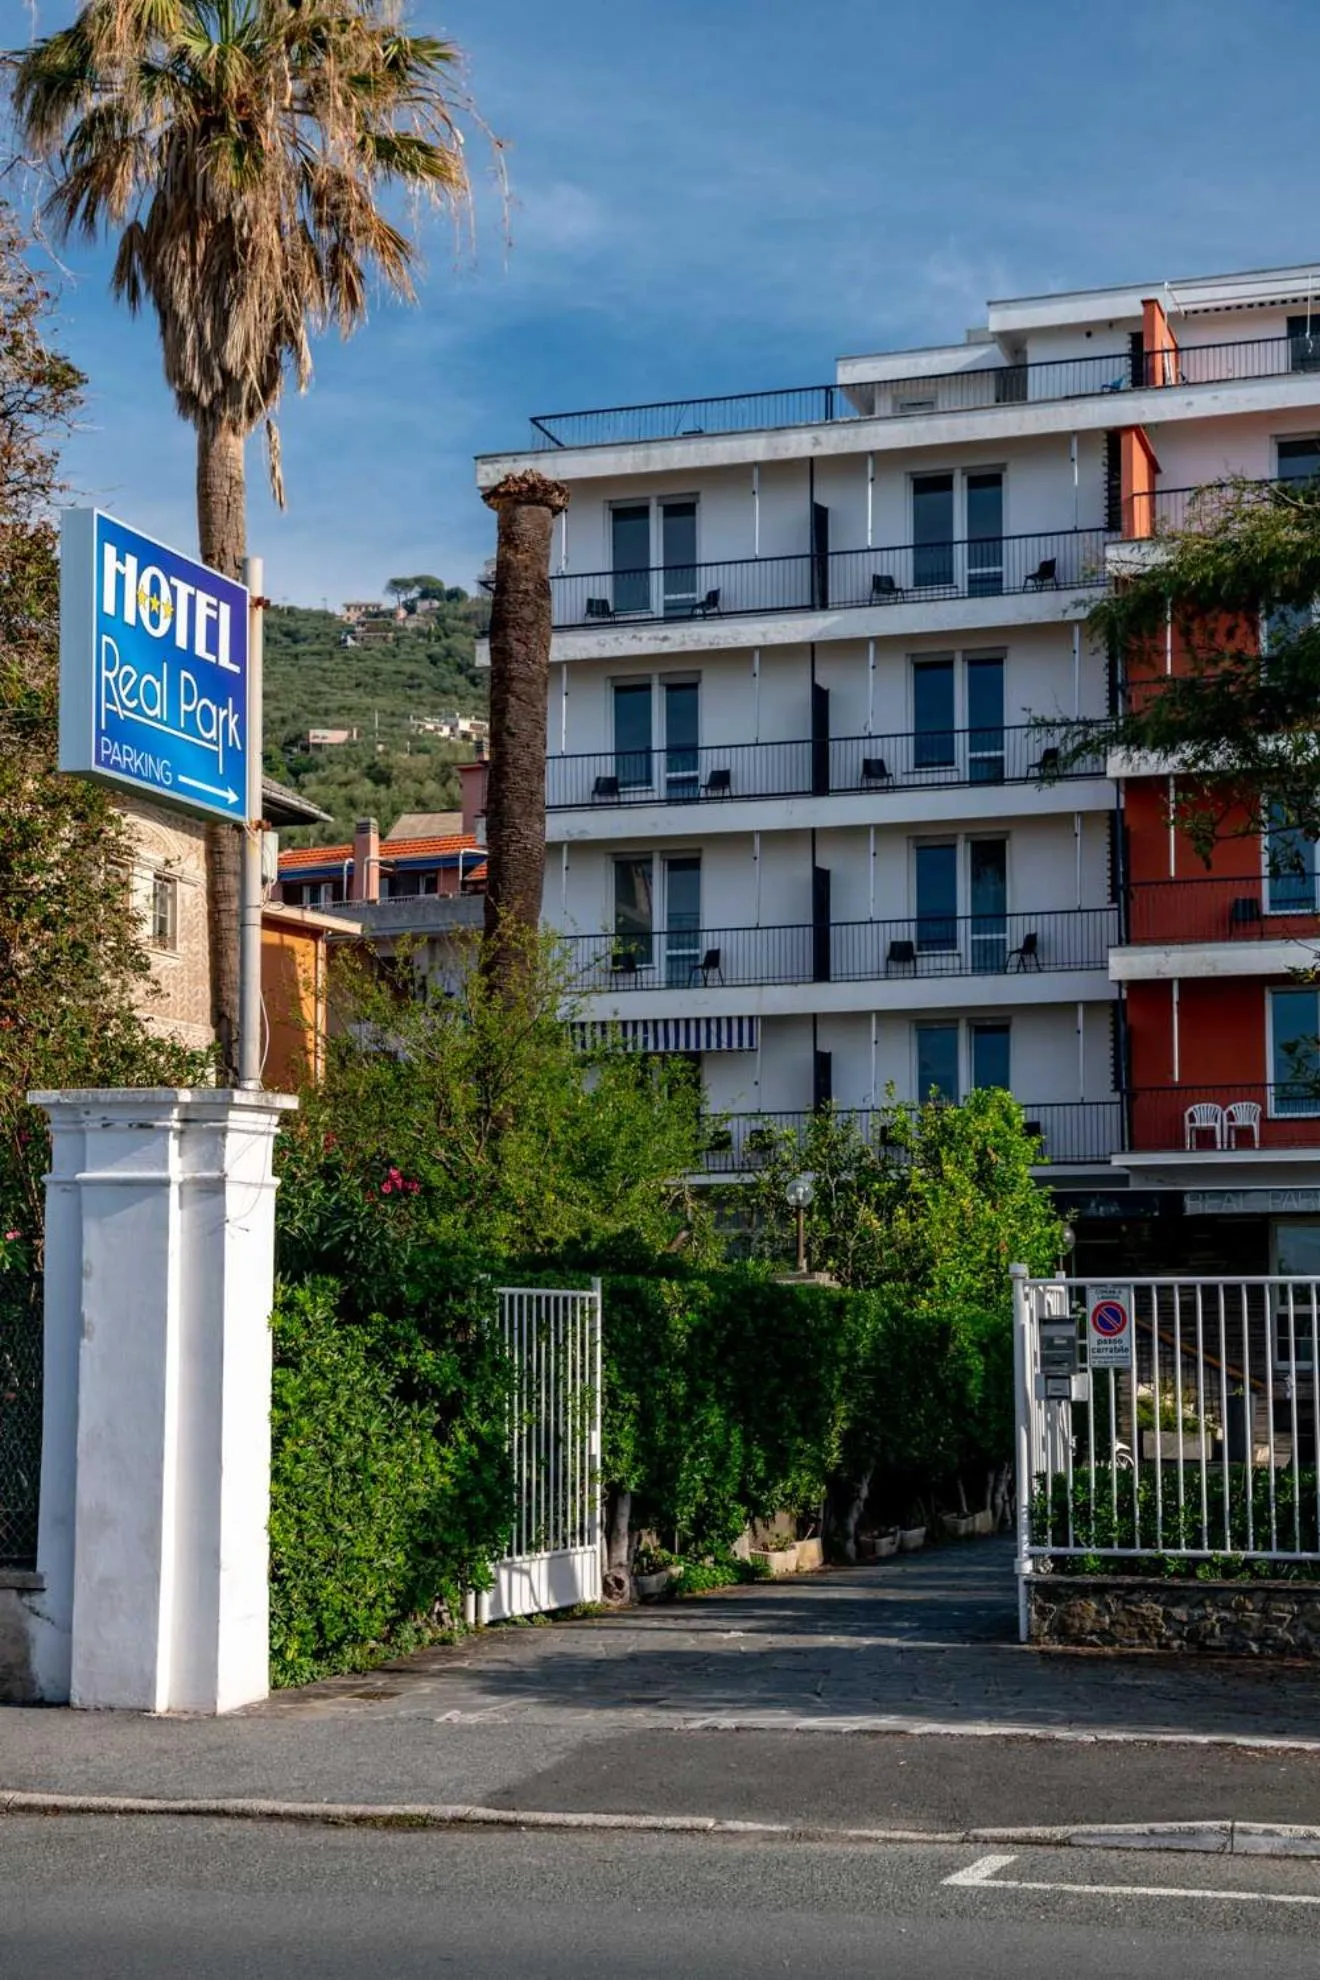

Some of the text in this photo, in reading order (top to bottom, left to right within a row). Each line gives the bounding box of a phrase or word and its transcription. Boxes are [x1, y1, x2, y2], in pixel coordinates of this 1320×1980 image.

[103, 542, 241, 674] HOTEL
[101, 635, 241, 774] Real Park
[101, 736, 172, 785] PARKING
[1185, 1191, 1320, 1214] REAL PAR
